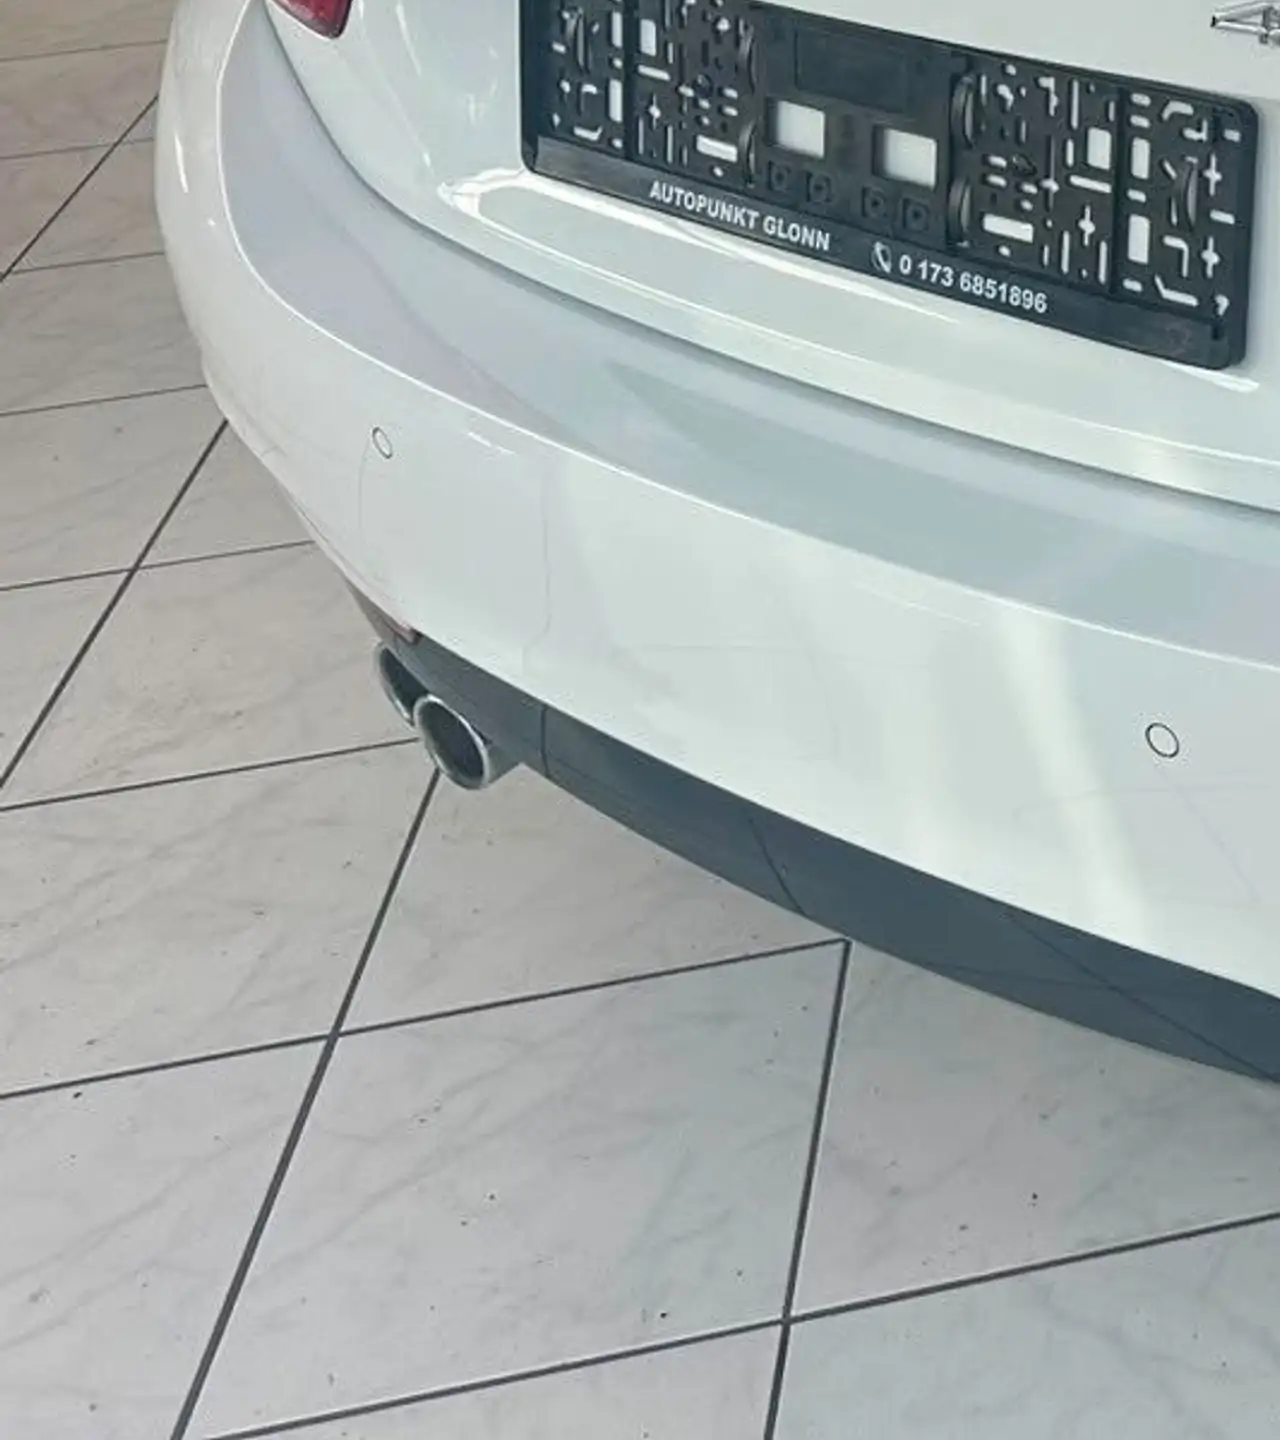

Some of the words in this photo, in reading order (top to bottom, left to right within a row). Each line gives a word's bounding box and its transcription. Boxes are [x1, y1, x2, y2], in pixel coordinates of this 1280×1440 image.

[650, 180, 759, 229] AUTOPUNKT
[763, 215, 830, 251] GLONN
[899, 254, 912, 275] 0
[918, 259, 954, 287] 173
[960, 271, 1048, 313] 6851896
